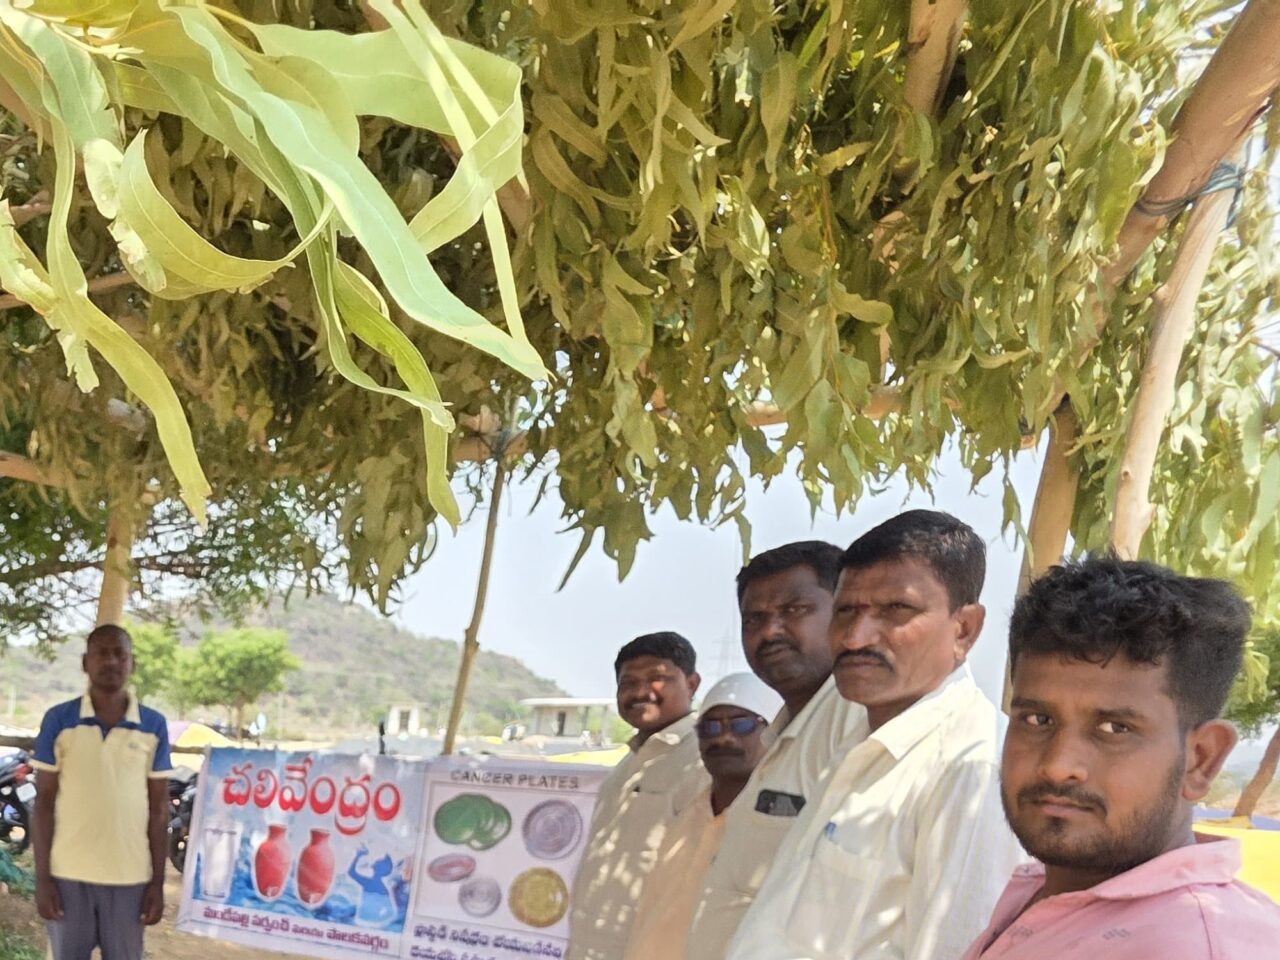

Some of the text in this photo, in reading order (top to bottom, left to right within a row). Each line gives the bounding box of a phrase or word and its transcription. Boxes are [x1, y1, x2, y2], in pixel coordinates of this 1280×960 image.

[223, 756, 401, 836] చలివేంద్రం
[450, 769, 579, 790] CANCER PLATES
